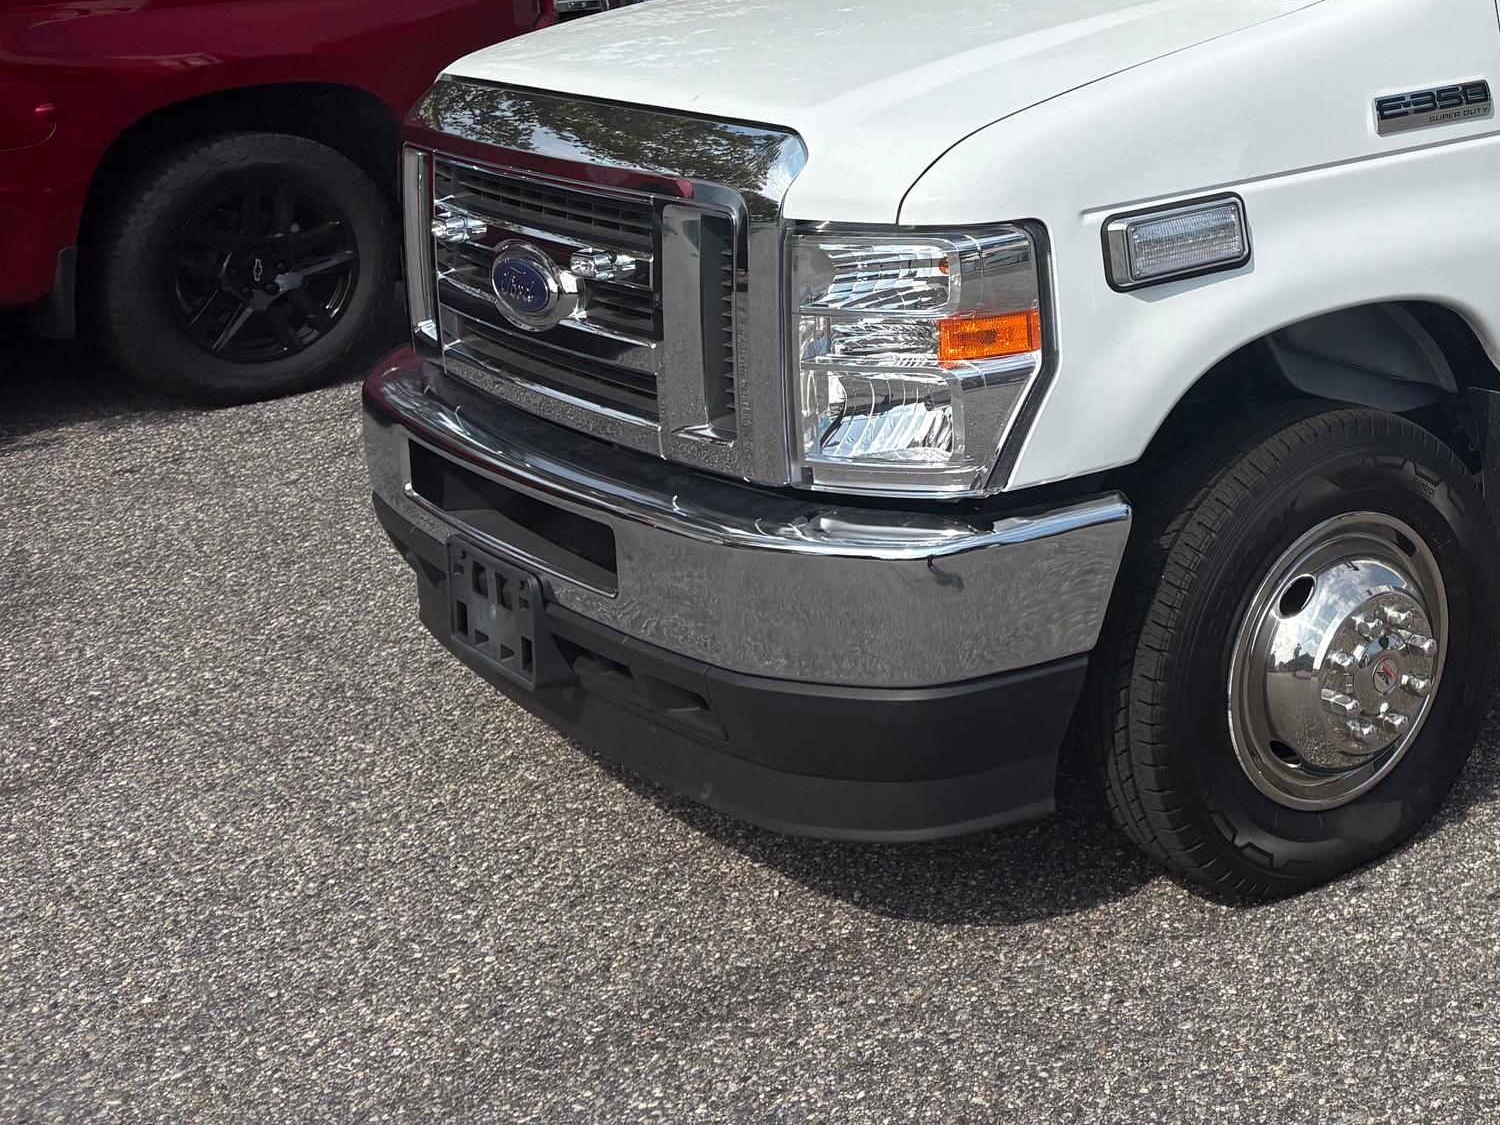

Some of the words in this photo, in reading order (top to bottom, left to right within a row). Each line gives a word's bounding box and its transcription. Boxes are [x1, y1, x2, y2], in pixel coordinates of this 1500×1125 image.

[1377, 80, 1490, 120] E-350
[1428, 111, 1461, 123] SUPER
[1463, 106, 1489, 117] DUTY
[501, 266, 535, 302] Ford
